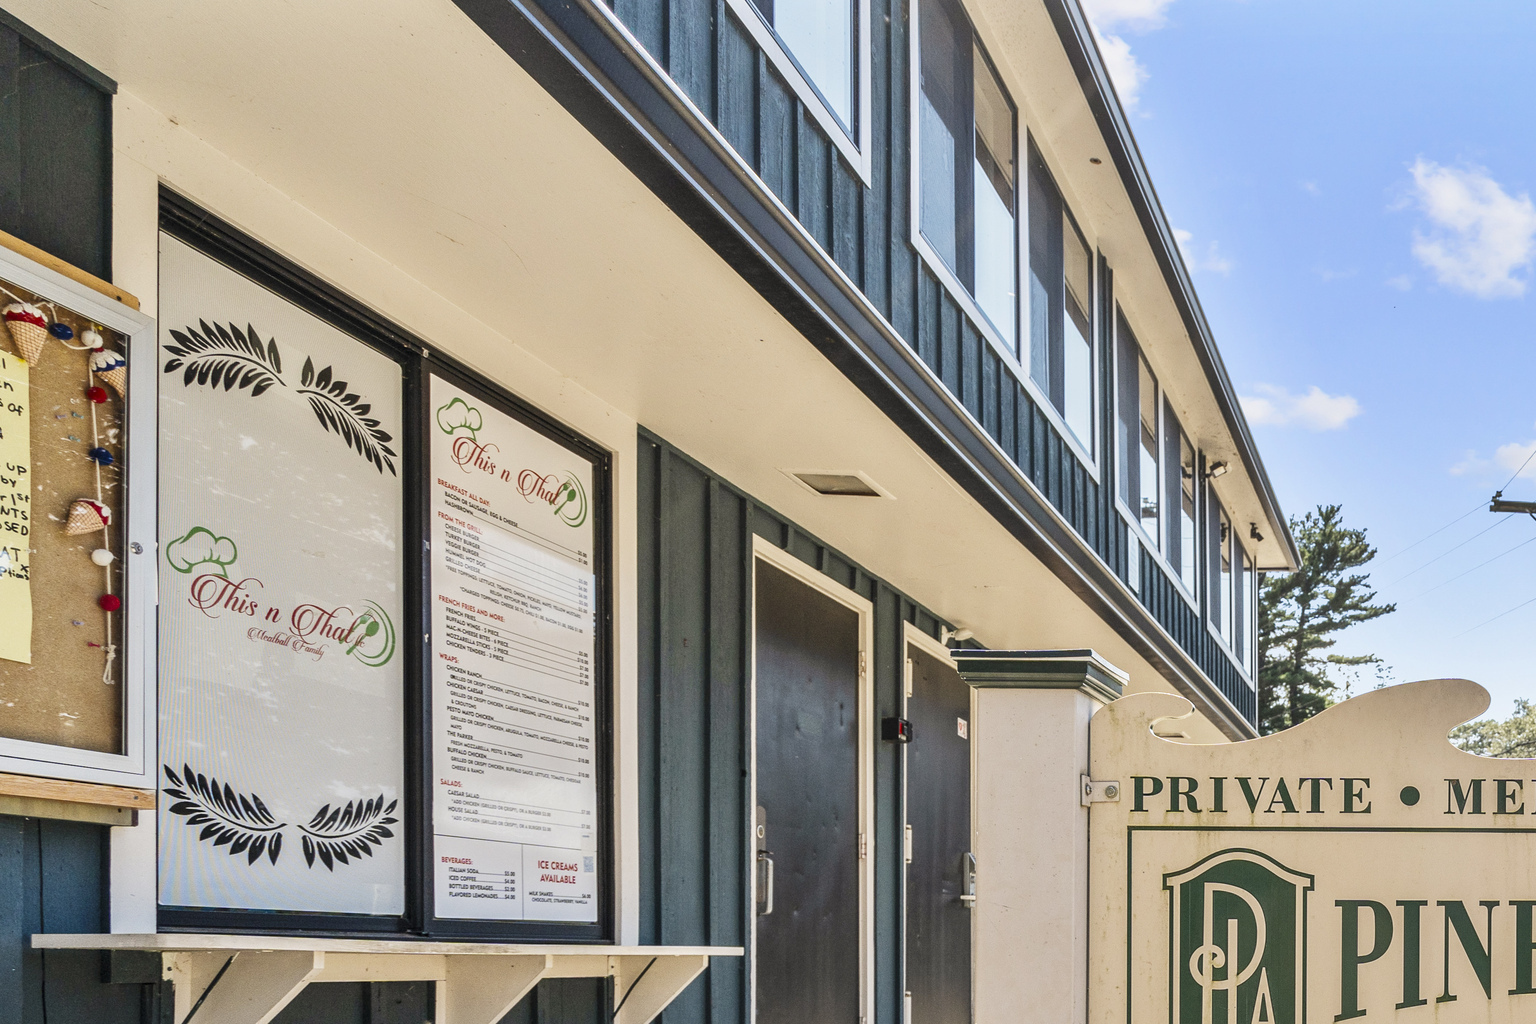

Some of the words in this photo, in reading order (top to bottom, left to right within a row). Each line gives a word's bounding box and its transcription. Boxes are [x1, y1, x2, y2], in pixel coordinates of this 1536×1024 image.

[451, 437, 500, 474] This
[500, 469, 513, 482] n
[516, 469, 575, 505] That
[438, 478, 467, 497] BREAKFAST
[469, 492, 478, 502] ALL
[479, 496, 490, 507] DAY:
[438, 511, 454, 523] FROM
[455, 518, 465, 528] THE
[467, 523, 483, 535] GRILL:
[188, 574, 264, 618] This
[265, 606, 282, 623] n
[289, 604, 377, 645] That
[439, 595, 460, 608] FRENCH
[462, 602, 475, 613] FRIES
[477, 607, 488, 617] AND
[489, 612, 505, 623] MORE:
[247, 627, 294, 647] Meatball
[292, 639, 329, 661] Family
[439, 653, 459, 664] WRAPS:
[441, 779, 463, 788] SALADS:
[1130, 777, 1372, 813] PRIVATE
[442, 857, 473, 865] BEVERAGES:
[538, 860, 549, 869] ICE
[551, 862, 578, 872] CREAMS
[540, 874, 576, 884] AVAILABLE
